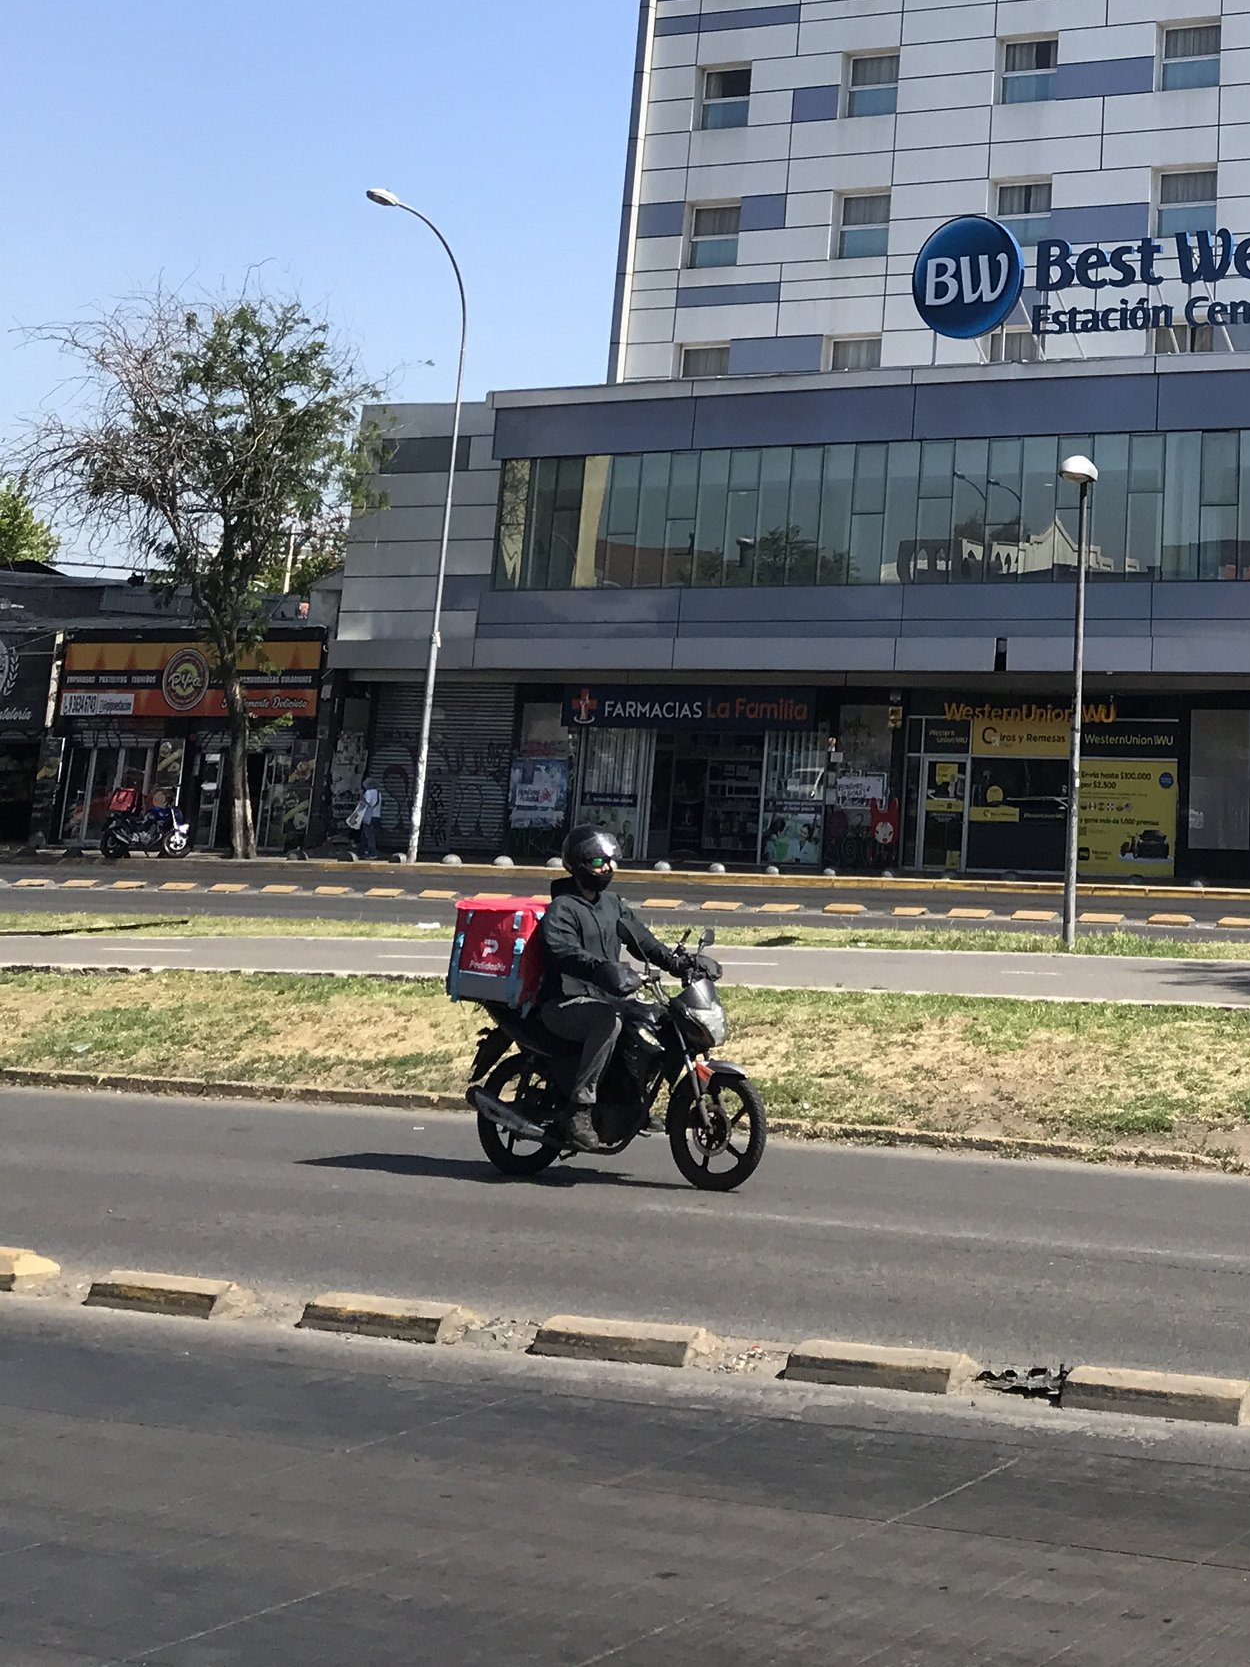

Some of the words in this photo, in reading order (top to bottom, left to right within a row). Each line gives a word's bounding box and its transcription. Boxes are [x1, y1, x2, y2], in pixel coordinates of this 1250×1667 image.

[924, 250, 1010, 308] BW
[1035, 236, 1164, 293] Best
[1031, 295, 1174, 336] Estación
[604, 700, 703, 719] FARMACIAS
[707, 697, 730, 719] La
[735, 696, 808, 720] Familia
[1018, 734, 1024, 744] y
[1026, 734, 1066, 743] Remesas
